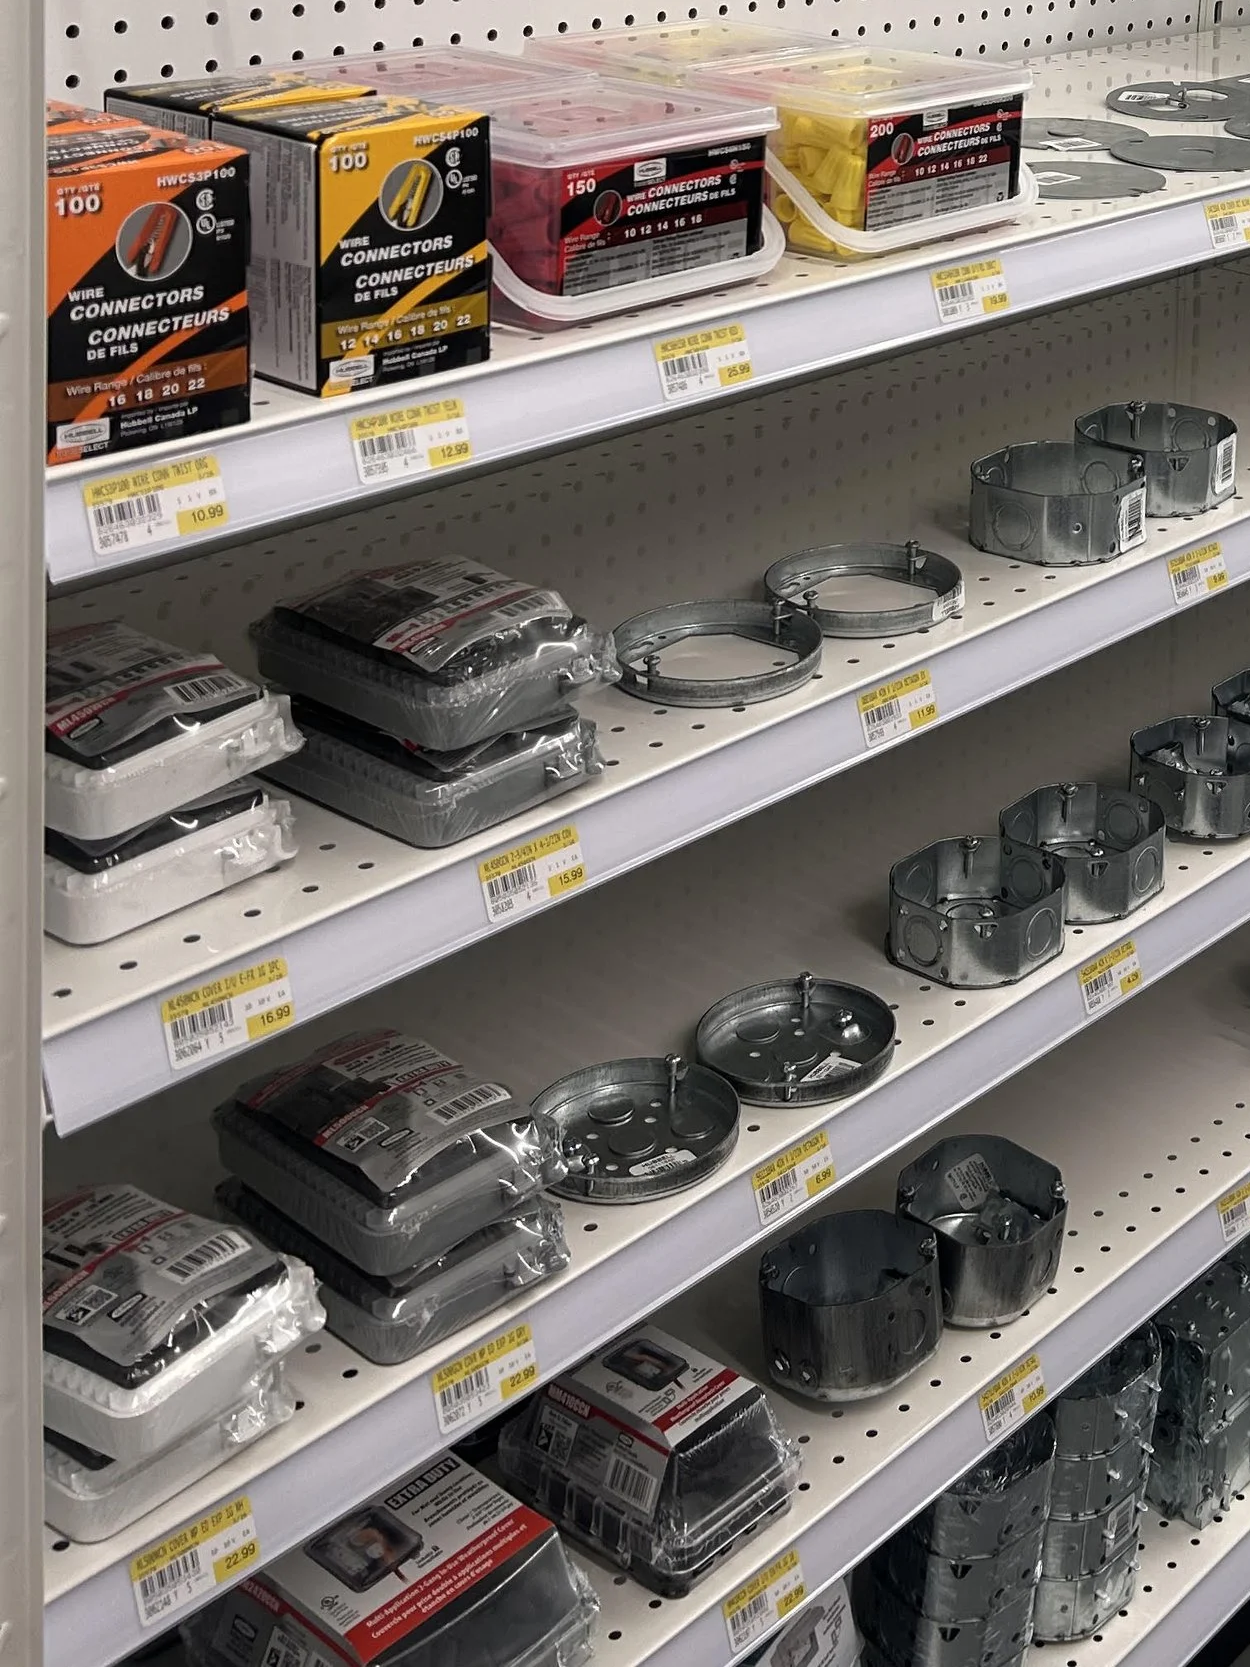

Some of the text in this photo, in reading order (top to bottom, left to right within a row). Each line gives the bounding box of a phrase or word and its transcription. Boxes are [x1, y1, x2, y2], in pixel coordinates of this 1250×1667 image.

[413, 127, 479, 147] HWCS4P100
[869, 122, 894, 138] 200
[933, 122, 991, 142] CONNECTORS
[917, 137, 981, 157] CONNECTEURS
[328, 152, 368, 172] 100
[915, 154, 988, 176] 10 12 14 22
[156, 166, 237, 187] HWCS3P100
[567, 178, 597, 197] 150
[626, 175, 721, 202] WIRE CONNECTORS
[55, 193, 101, 216] 100
[627, 191, 709, 216] CONNECTEURS
[624, 214, 703, 239] 10 12 14 16 18
[339, 236, 370, 249] WIRE
[340, 235, 453, 267] CONNECTORS
[355, 254, 474, 289] CONNECTEURS
[68, 287, 105, 302] WIRE
[69, 285, 205, 321] CONNECTORS
[354, 287, 399, 303] DE FILS
[87, 307, 230, 346] CONNECTEURS
[337, 325, 358, 335] Wire
[339, 314, 471, 351] 12 14 16 18 20 22
[86, 342, 139, 361] DE FILS
[727, 363, 750, 379] 25.99
[66, 367, 185, 398] Wire Range Calibre de
[108, 377, 206, 407] 16 18 20 22
[120, 406, 199, 430] Hubbell Canada LP
[441, 442, 469, 458] 12.99
[192, 505, 224, 524] 10.99
[917, 704, 935, 718] 11.99
[559, 867, 583, 886] 15.99
[202, 982, 223, 999] COVER
[260, 1005, 290, 1026] 16.99
[815, 1168, 831, 1184] 6.99
[509, 1366, 535, 1388] 22.99
[387, 1480, 427, 1508] EXTRA
[425, 1457, 460, 1489] DUTY
[169, 1513, 223, 1552] COVER EXP
[225, 1543, 256, 1570] 22.99
[366, 1587, 418, 1628] Multi-Application
[456, 1530, 498, 1567] Weatherproof
[495, 1518, 515, 1535] Cover
[402, 1604, 418, 1621] pour
[417, 1594, 433, 1610] prise
[431, 1579, 452, 1600] double
[456, 1546, 496, 1582] applications
